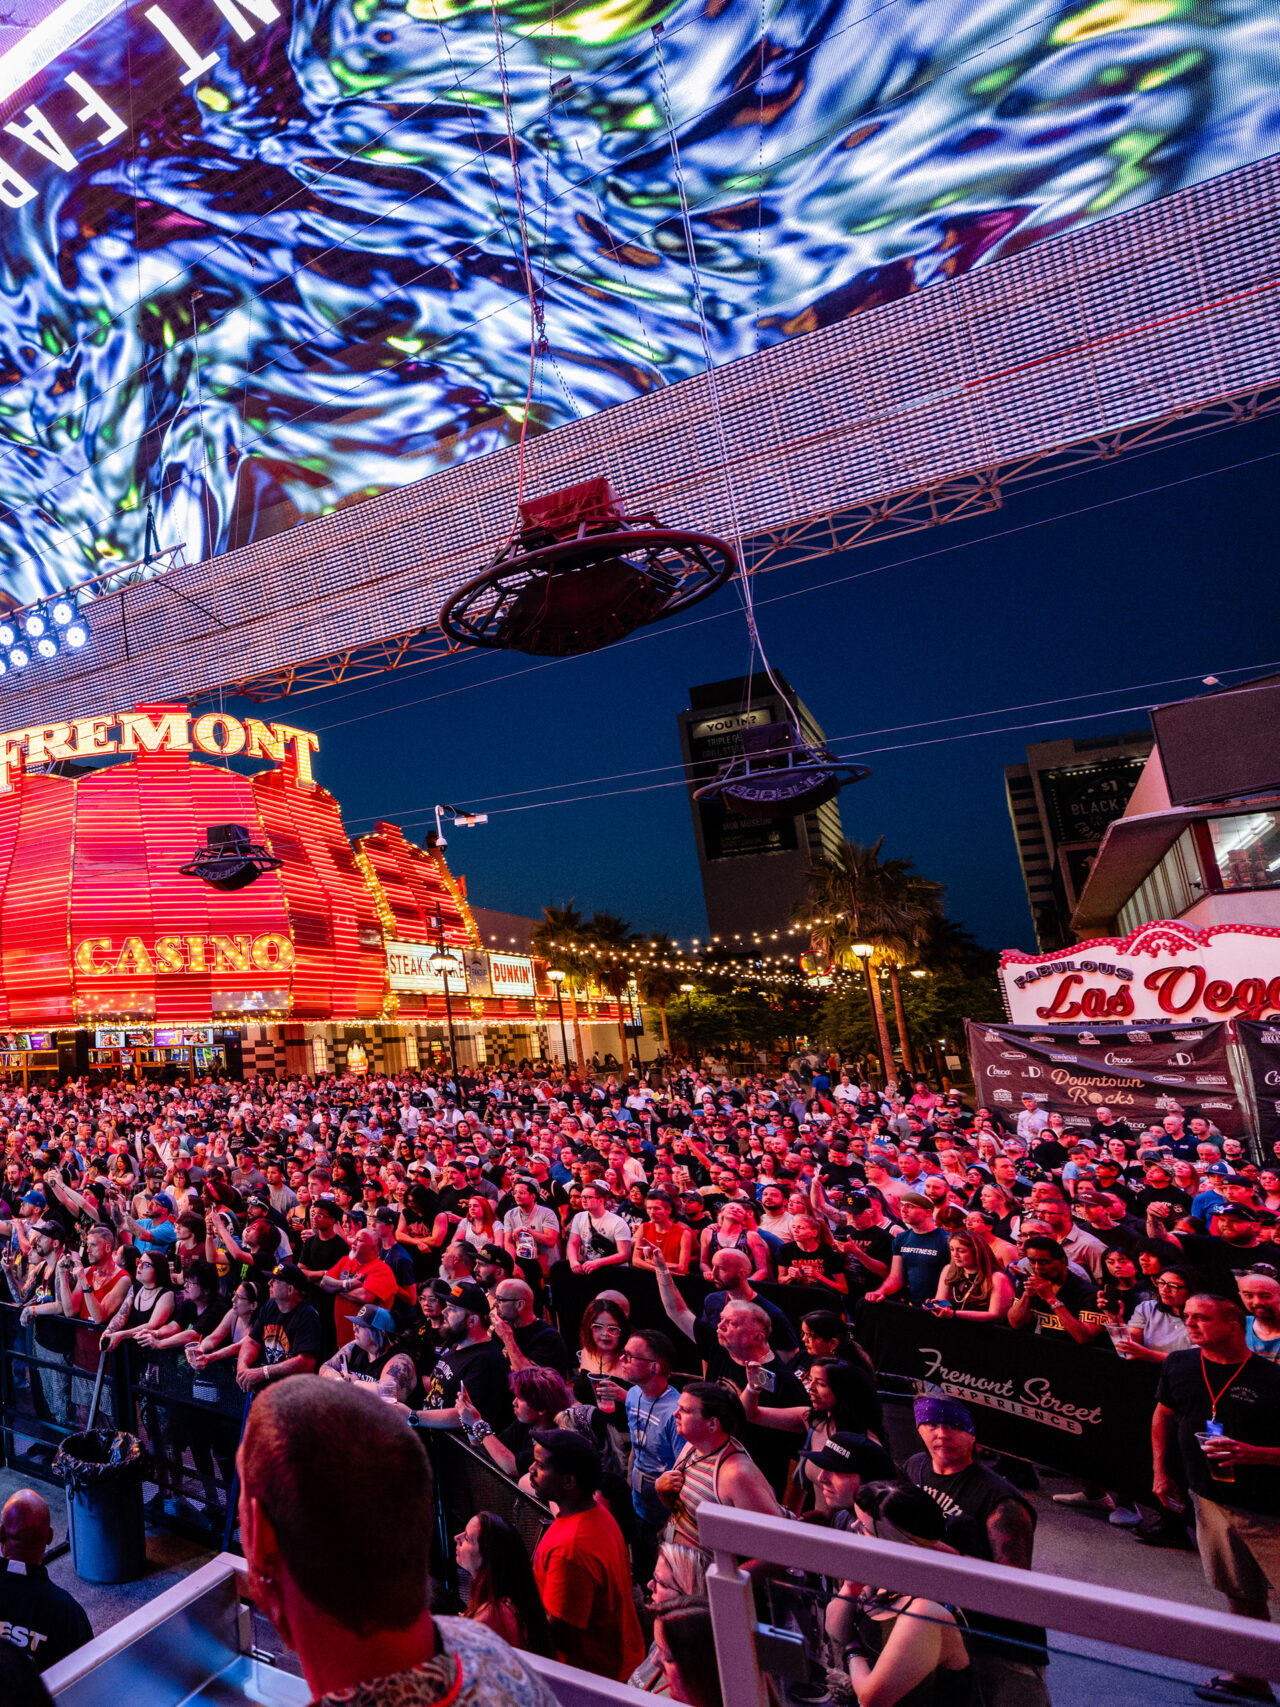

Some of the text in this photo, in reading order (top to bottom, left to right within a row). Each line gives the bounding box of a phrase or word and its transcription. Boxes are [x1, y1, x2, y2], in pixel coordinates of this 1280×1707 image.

[706, 720, 733, 733] YOU
[1100, 779, 1119, 792] $1
[1071, 799, 1119, 816] BLACK
[75, 931, 295, 976] CASINO
[390, 954, 424, 976] STEAK
[493, 962, 531, 984] DUNKIN'
[1014, 960, 1134, 989] FABULOUS
[1036, 974, 1135, 1020] Las
[1104, 1052, 1134, 1066] Circa
[987, 1064, 1012, 1078] Circa
[1051, 1068, 1145, 1089] Downtown
[1067, 1086, 1135, 1106] Rocks
[919, 1347, 1103, 1426] Fremont Street
[944, 1384, 1079, 1432] EXPERIENCE
